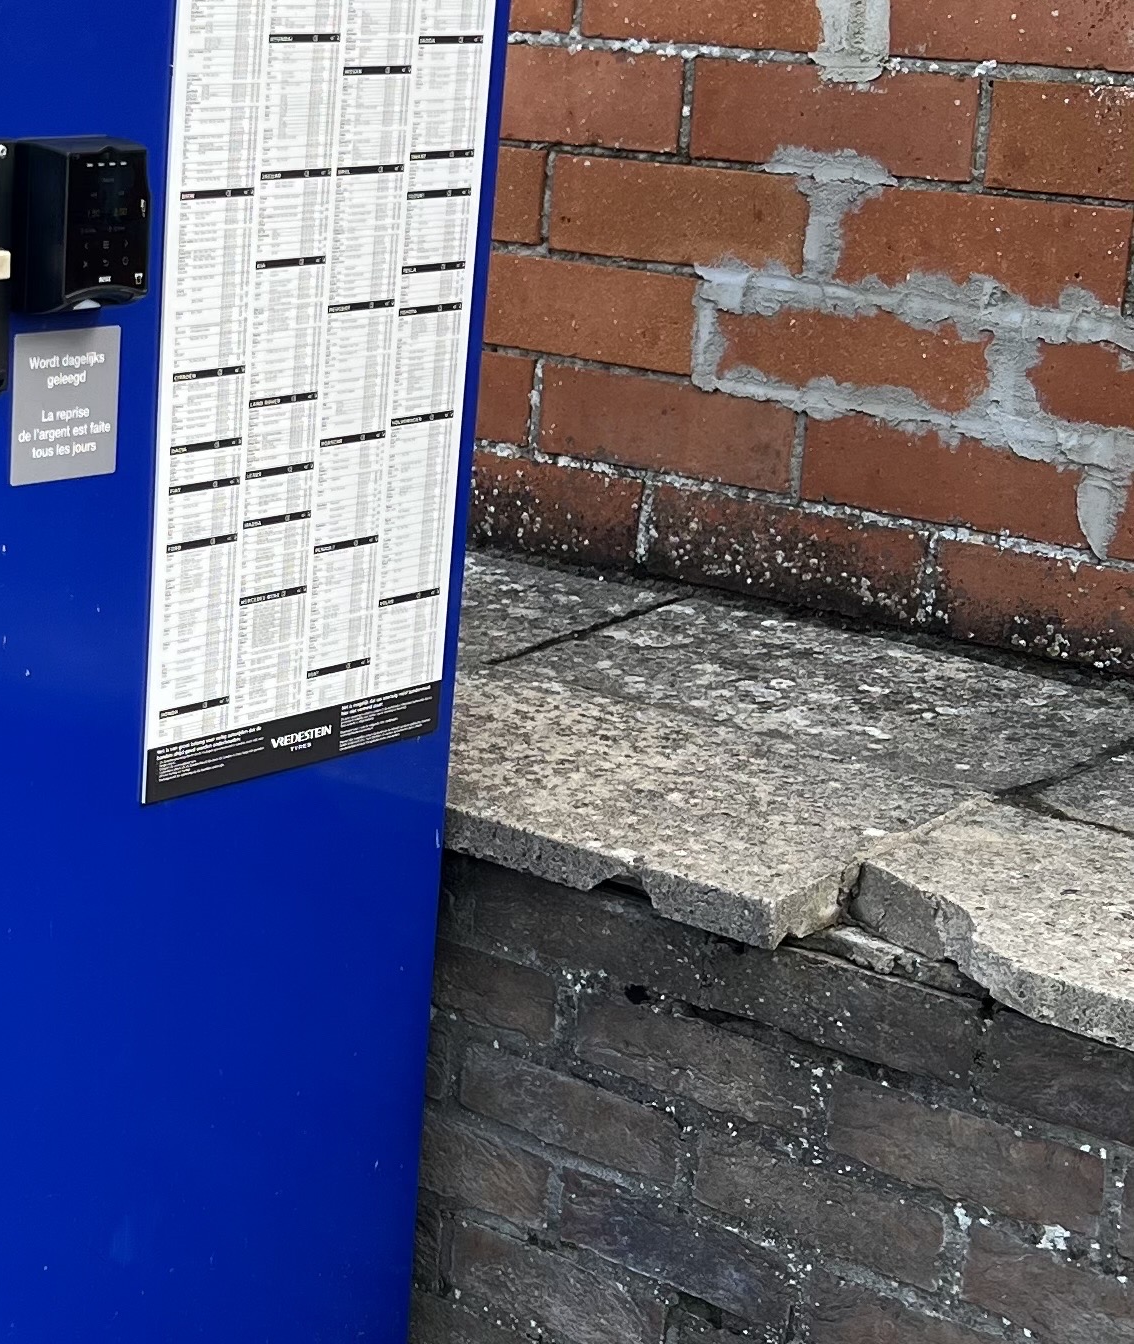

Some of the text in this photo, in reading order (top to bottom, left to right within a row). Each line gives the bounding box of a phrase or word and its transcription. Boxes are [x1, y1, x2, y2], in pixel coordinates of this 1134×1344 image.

[29, 351, 105, 370] Wordt dagelijks
[47, 370, 87, 389] geleegd
[41, 406, 90, 423] La reprise
[18, 420, 111, 443] de l'argent est faite
[31, 441, 97, 458] tous les jours
[270, 724, 333, 749] VREDESTEIN
